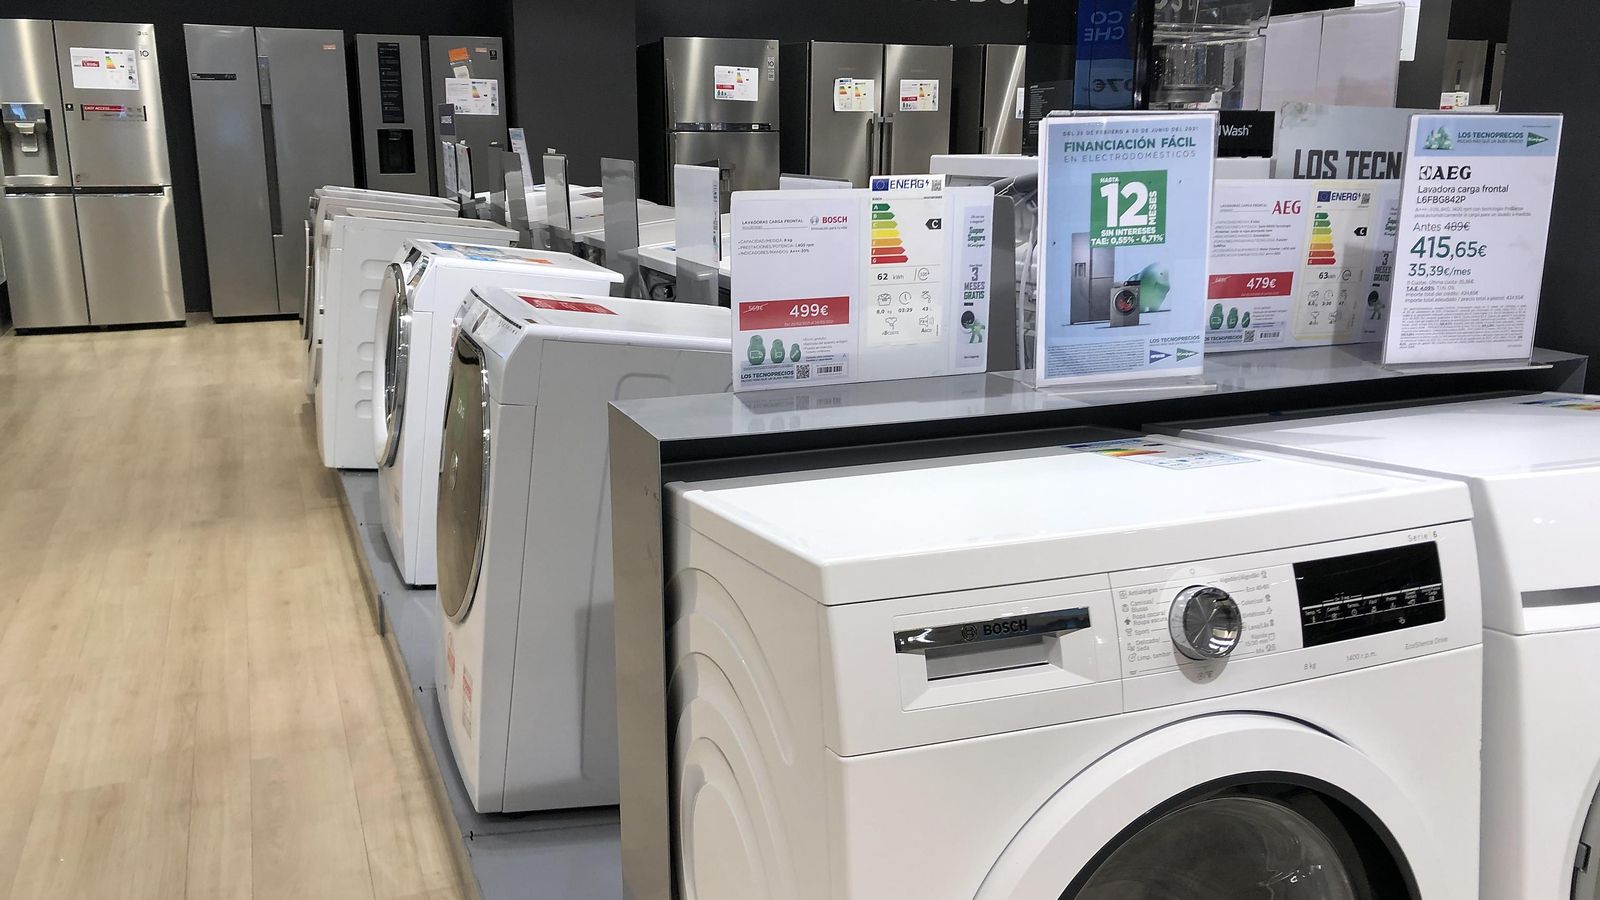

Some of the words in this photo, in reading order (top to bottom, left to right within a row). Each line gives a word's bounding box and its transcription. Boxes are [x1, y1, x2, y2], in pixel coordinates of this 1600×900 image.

[1064, 136, 1156, 152] FINANCIACIÓN
[1162, 134, 1196, 148] FÁCIL
[1064, 155, 1077, 163] EN
[1293, 149, 1338, 179] LOS
[1432, 166, 1471, 180] AEG
[890, 179, 924, 190] ENERG
[1418, 185, 1456, 194] Lavadora
[1458, 186, 1480, 195] carga
[1482, 184, 1508, 193] frontal
[1331, 192, 1358, 200] ENERG
[1416, 196, 1466, 204] L6FBG842P
[1100, 182, 1148, 228] 12
[1148, 190, 1158, 225] MESES
[1272, 200, 1302, 214] AEG
[932, 220, 938, 228] C
[1412, 222, 1442, 232] Antes
[1444, 222, 1470, 232] 489€
[1116, 227, 1156, 236] INTERESES
[1410, 236, 1488, 260] 415,65€
[1382, 254, 1390, 265] 3
[972, 267, 978, 281] 3
[1408, 263, 1471, 278] 35,39€/mes
[964, 282, 985, 290] MESES
[1246, 276, 1277, 290] 479€
[964, 290, 984, 300] GRATIS
[790, 304, 828, 318] 499€
[752, 370, 794, 378] TECNOPRECIOS
[984, 619, 1028, 636] BOSCH
